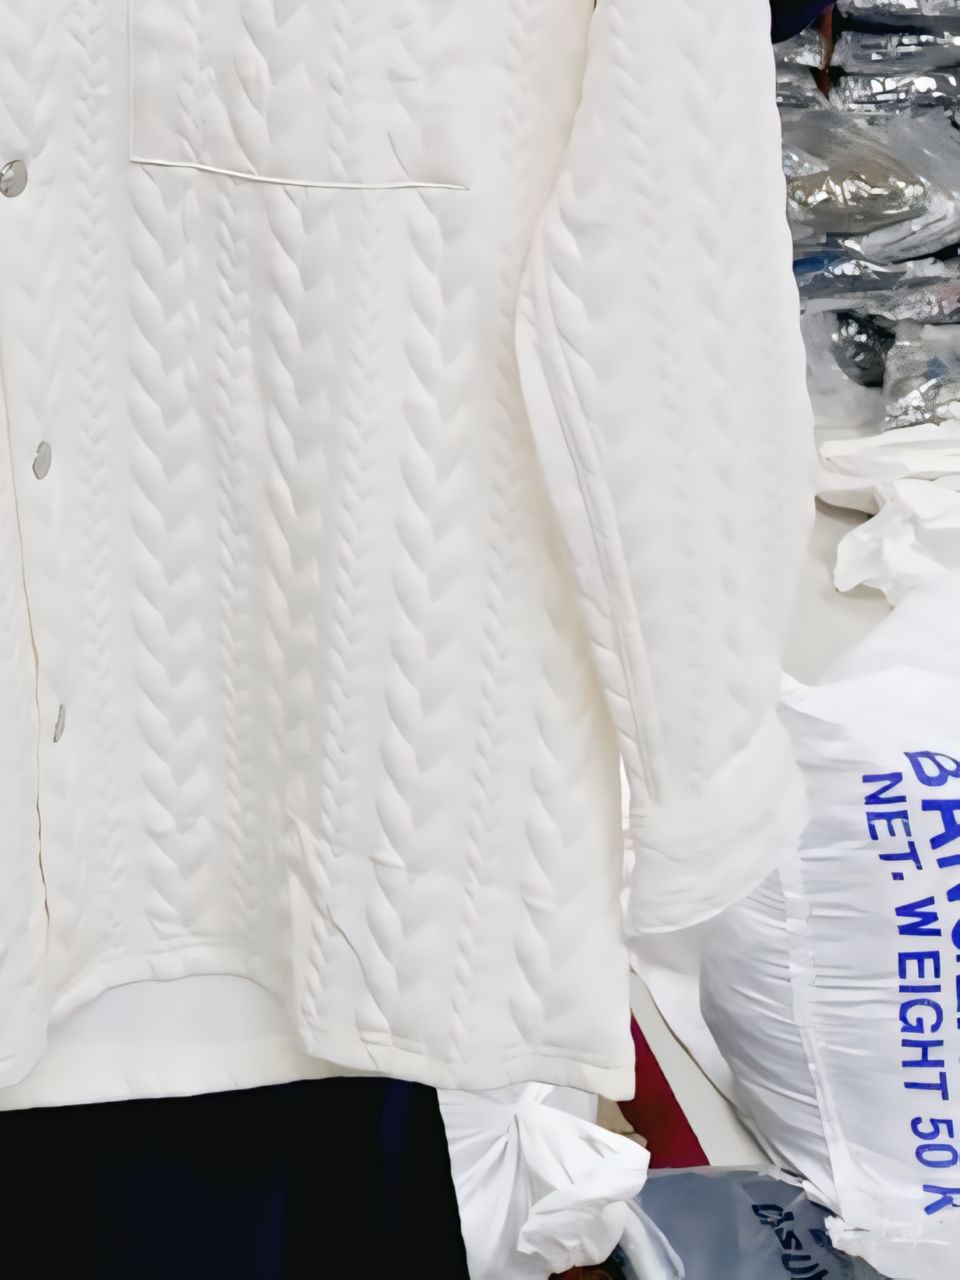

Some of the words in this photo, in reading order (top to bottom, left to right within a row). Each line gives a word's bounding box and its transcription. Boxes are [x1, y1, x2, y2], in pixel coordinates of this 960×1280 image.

[862, 772, 923, 881] NET.
[895, 896, 949, 1101] WEIGHT
[910, 1117, 958, 1168] 50
